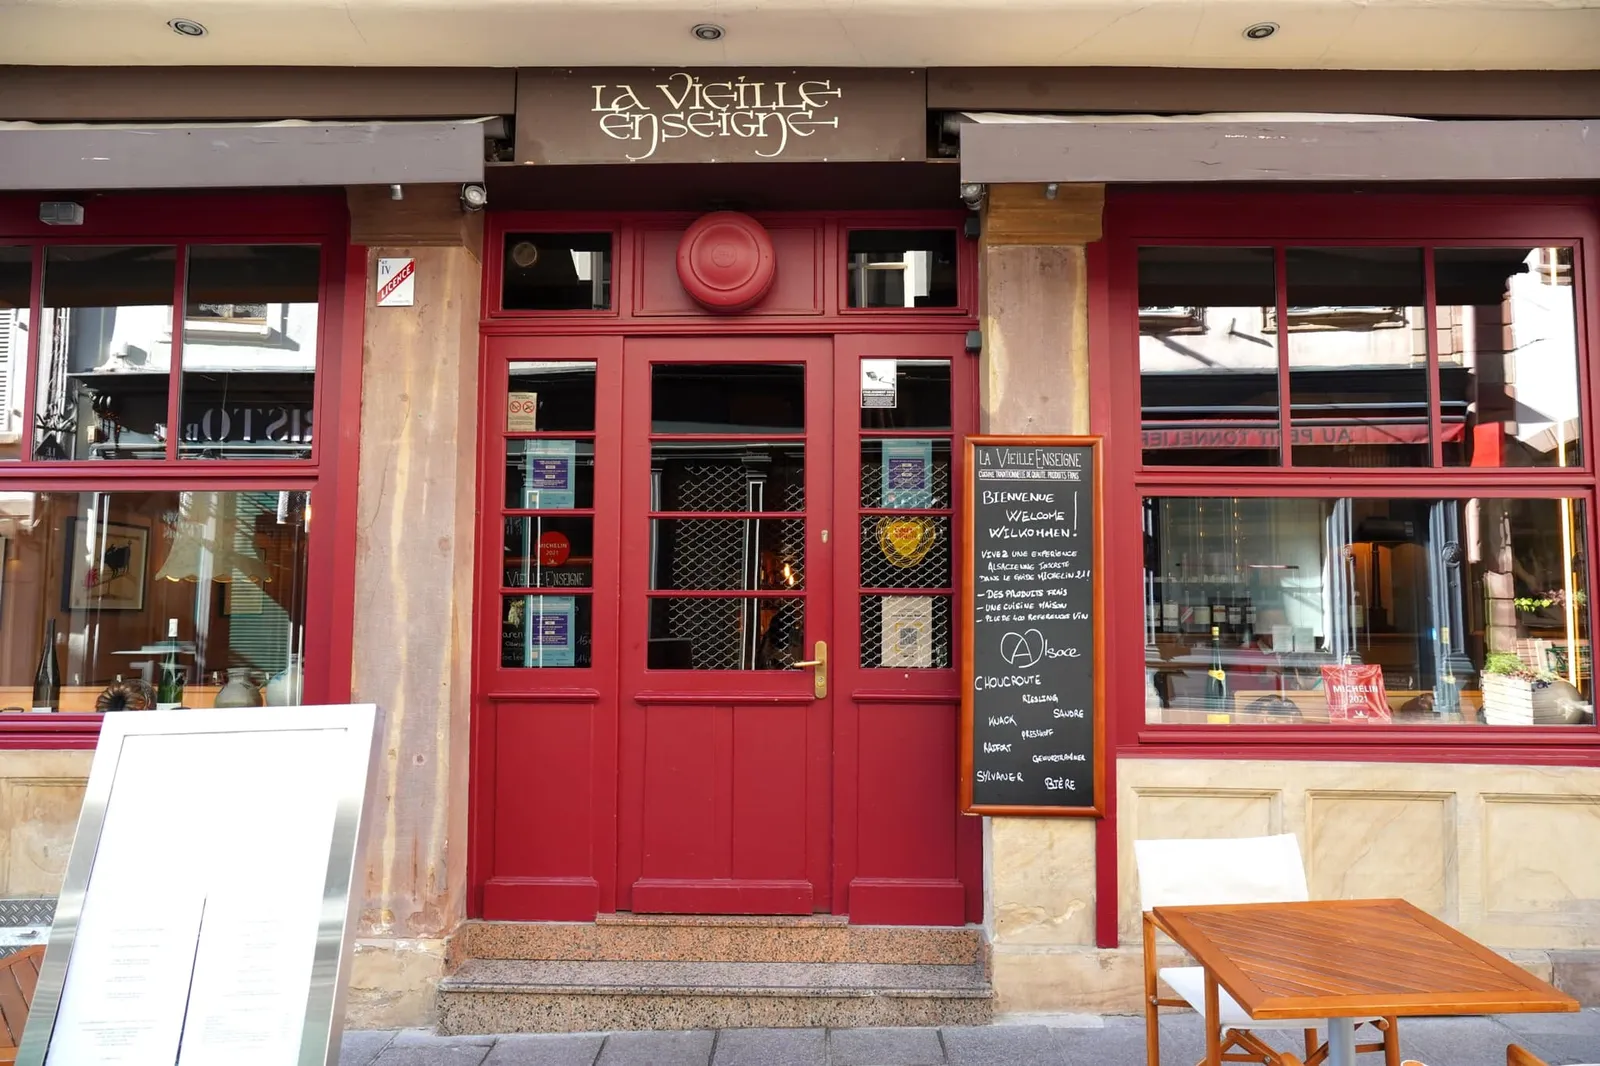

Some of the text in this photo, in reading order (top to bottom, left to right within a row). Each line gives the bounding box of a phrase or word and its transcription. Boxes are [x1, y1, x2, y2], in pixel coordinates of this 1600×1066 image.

[591, 72, 842, 112] LA VIEILLE
[381, 265, 391, 275] IV
[381, 264, 411, 299] LICENCE
[979, 448, 1082, 469] LA VIEILLE ENSEIGNE
[983, 490, 1055, 504] BIENVENUE
[1006, 509, 1065, 522] WELCOME
[1011, 550, 1028, 558] UNE
[979, 575, 1000, 583] DANS
[1037, 572, 1075, 581] MICHELIN
[985, 588, 1068, 599] DES PRODUITS FRAIS
[985, 601, 1068, 612] UNE CUISINE MAISON
[1072, 611, 1089, 621] VIN
[974, 674, 1042, 691] CHOUCROUTE
[1332, 685, 1378, 693] MICHELIN
[1022, 694, 1059, 704] RIESLING
[1349, 695, 1369, 704] 2021
[1053, 708, 1084, 719] SANDRE
[976, 770, 1024, 783] SYLVANER
[1044, 777, 1076, 791] BIÈRE
